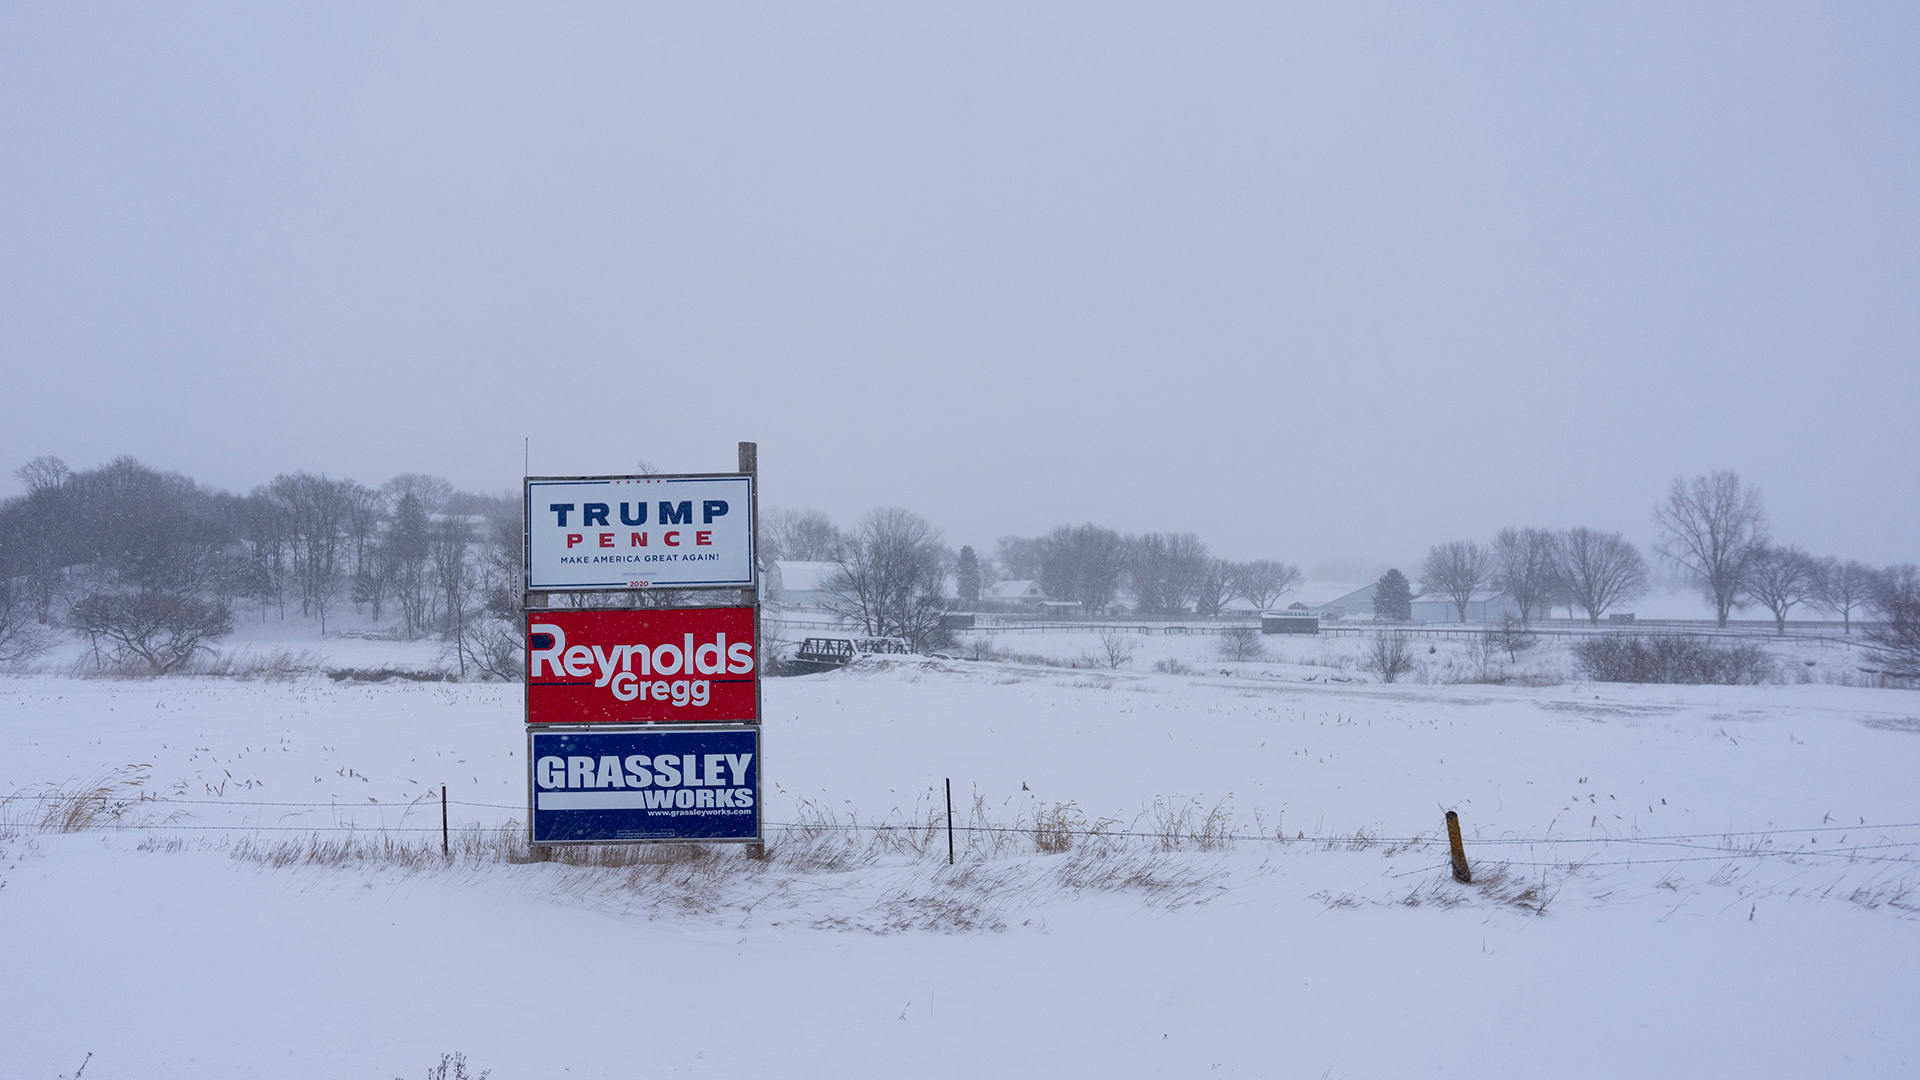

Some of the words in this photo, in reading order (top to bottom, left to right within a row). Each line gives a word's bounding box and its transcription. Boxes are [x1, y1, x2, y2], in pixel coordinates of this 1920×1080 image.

[550, 500, 729, 527] TRUMP
[567, 530, 712, 549] PENCE
[560, 555, 590, 564] MAKE
[593, 555, 641, 563] AMERICA
[645, 554, 678, 562] GREAT
[682, 553, 719, 562] AGAIN!
[531, 623, 754, 688] Reynolds
[611, 671, 710, 707] Gregg
[537, 753, 753, 789] GRASSLEY
[644, 788, 754, 809] WORKS
[648, 809, 752, 817] www.grassleyworks.com
